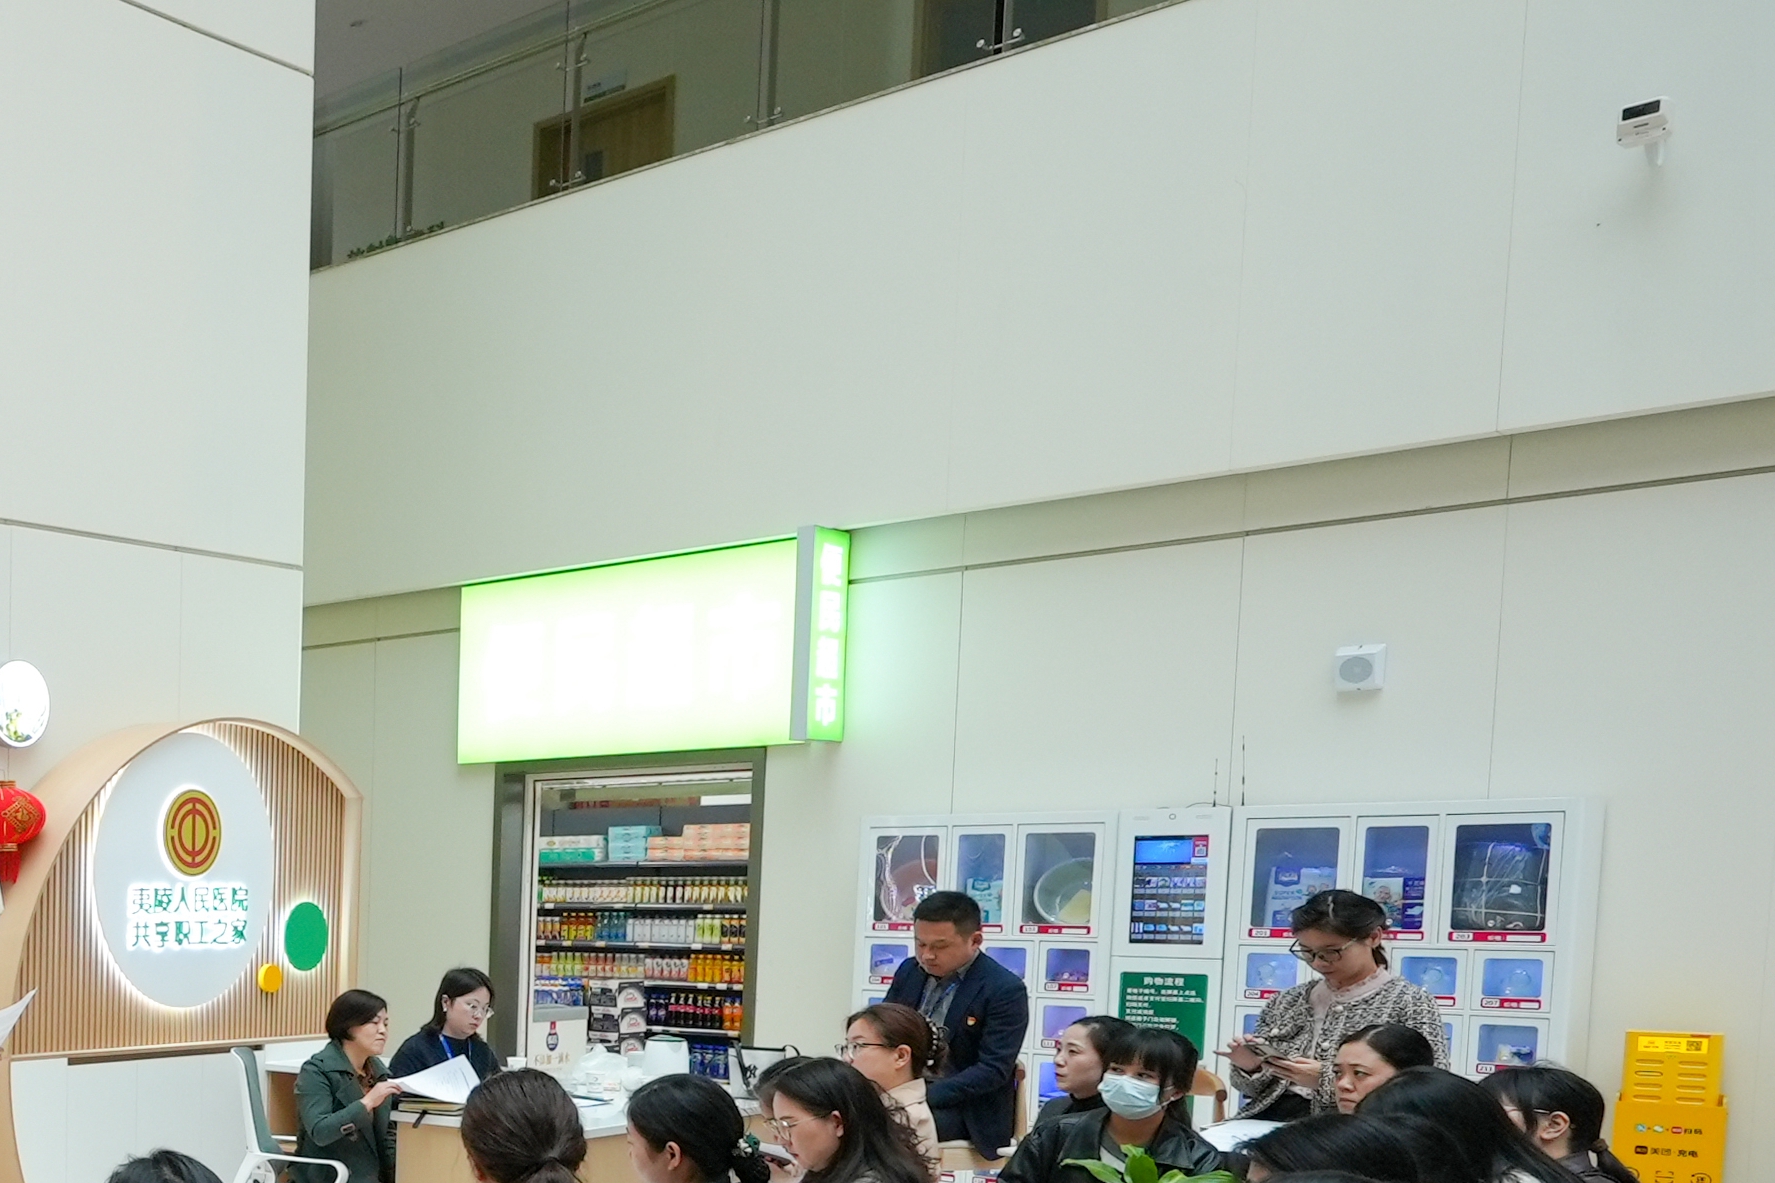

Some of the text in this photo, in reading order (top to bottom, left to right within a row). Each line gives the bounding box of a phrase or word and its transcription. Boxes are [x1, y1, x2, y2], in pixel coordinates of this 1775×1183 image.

[131, 885, 249, 915] 夷陵人民医院
[131, 918, 248, 948] 共享职工之家
